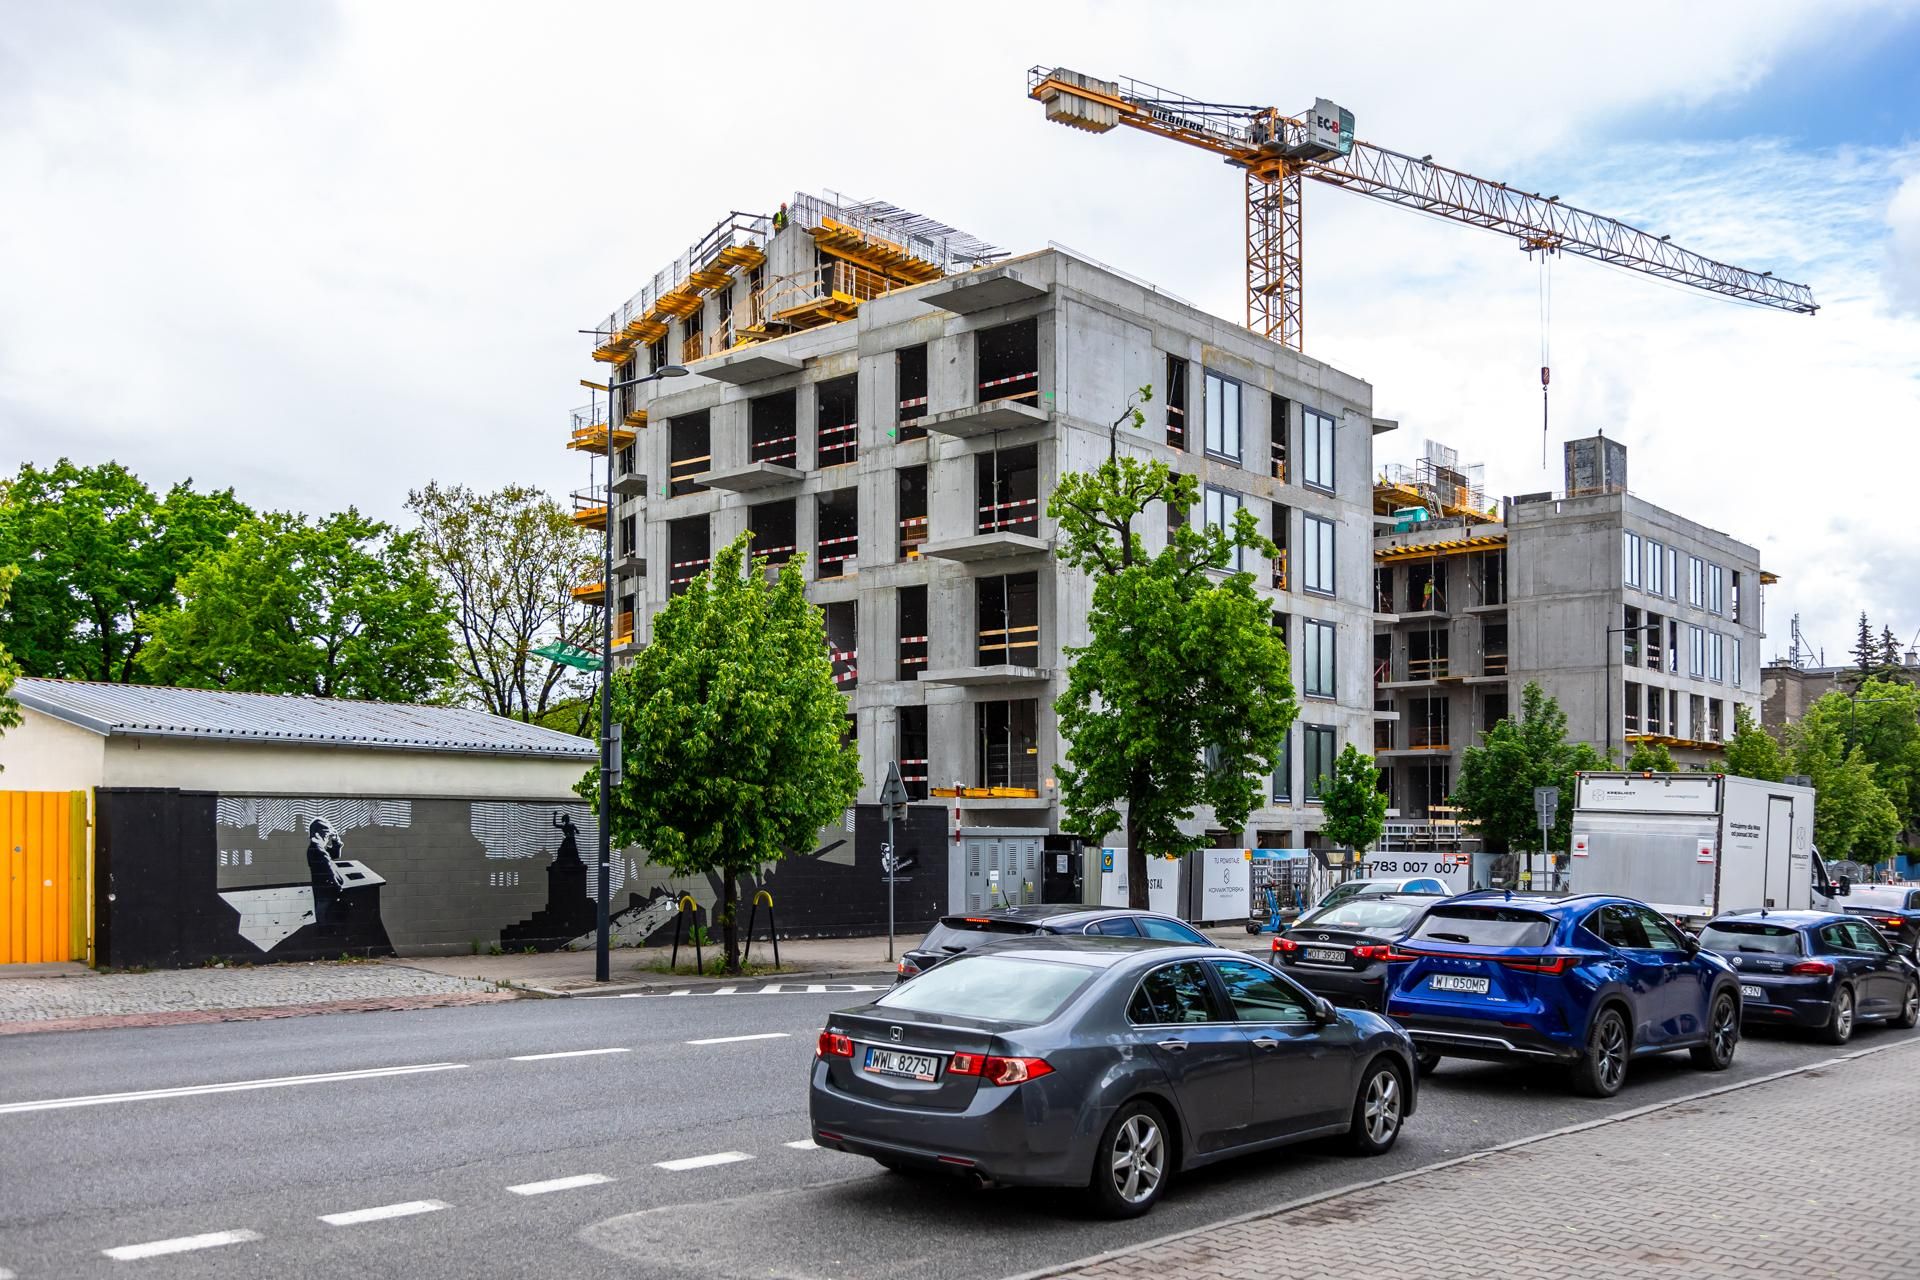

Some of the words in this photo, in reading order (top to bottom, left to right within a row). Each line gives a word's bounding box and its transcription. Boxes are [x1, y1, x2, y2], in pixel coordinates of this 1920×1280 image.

[1153, 110, 1204, 132] LIEBHERR
[1317, 115, 1339, 134] EC-B
[1372, 860, 1398, 872] 783
[1403, 861, 1428, 873] 007
[1434, 862, 1459, 874] 007
[1148, 878, 1163, 890] STAL
[1322, 950, 1345, 960] 39320
[1453, 977, 1486, 991] 050MR
[872, 1050, 894, 1070] WWL
[897, 1054, 934, 1076] 8275L
